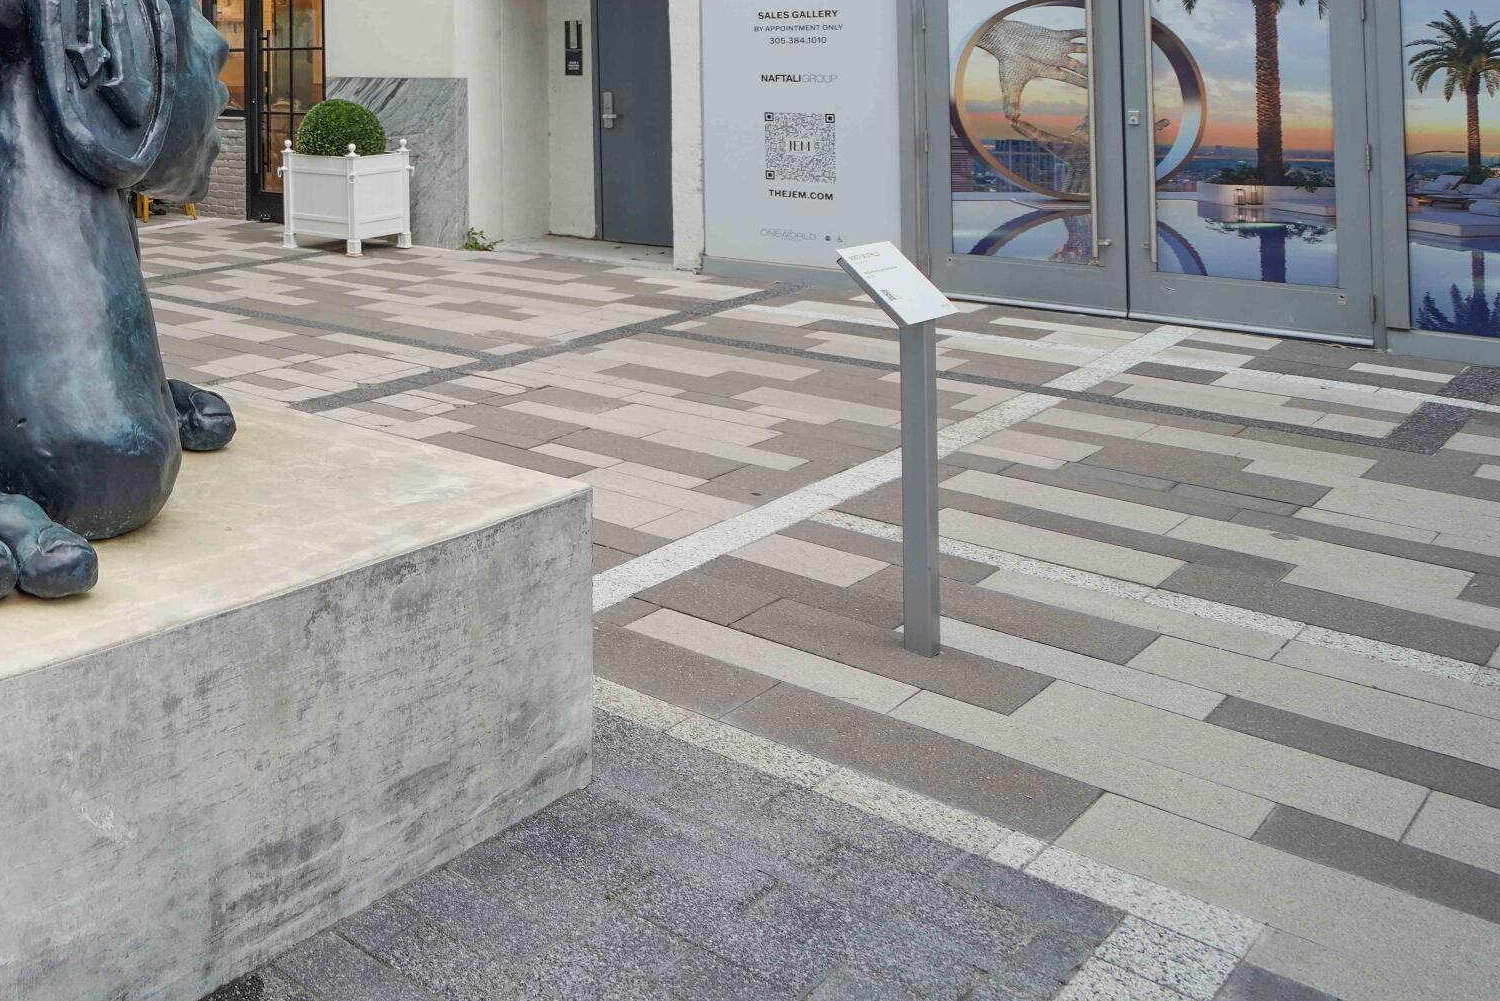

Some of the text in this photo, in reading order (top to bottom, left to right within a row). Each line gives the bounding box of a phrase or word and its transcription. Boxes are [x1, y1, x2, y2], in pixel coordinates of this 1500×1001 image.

[757, 9, 839, 20] SALES GALLERY
[765, 24, 821, 32] APPOINTMENT
[821, 23, 844, 31] ONLY
[769, 36, 827, 45] 305.384.1010
[768, 188, 834, 201] THEJEM.COM
